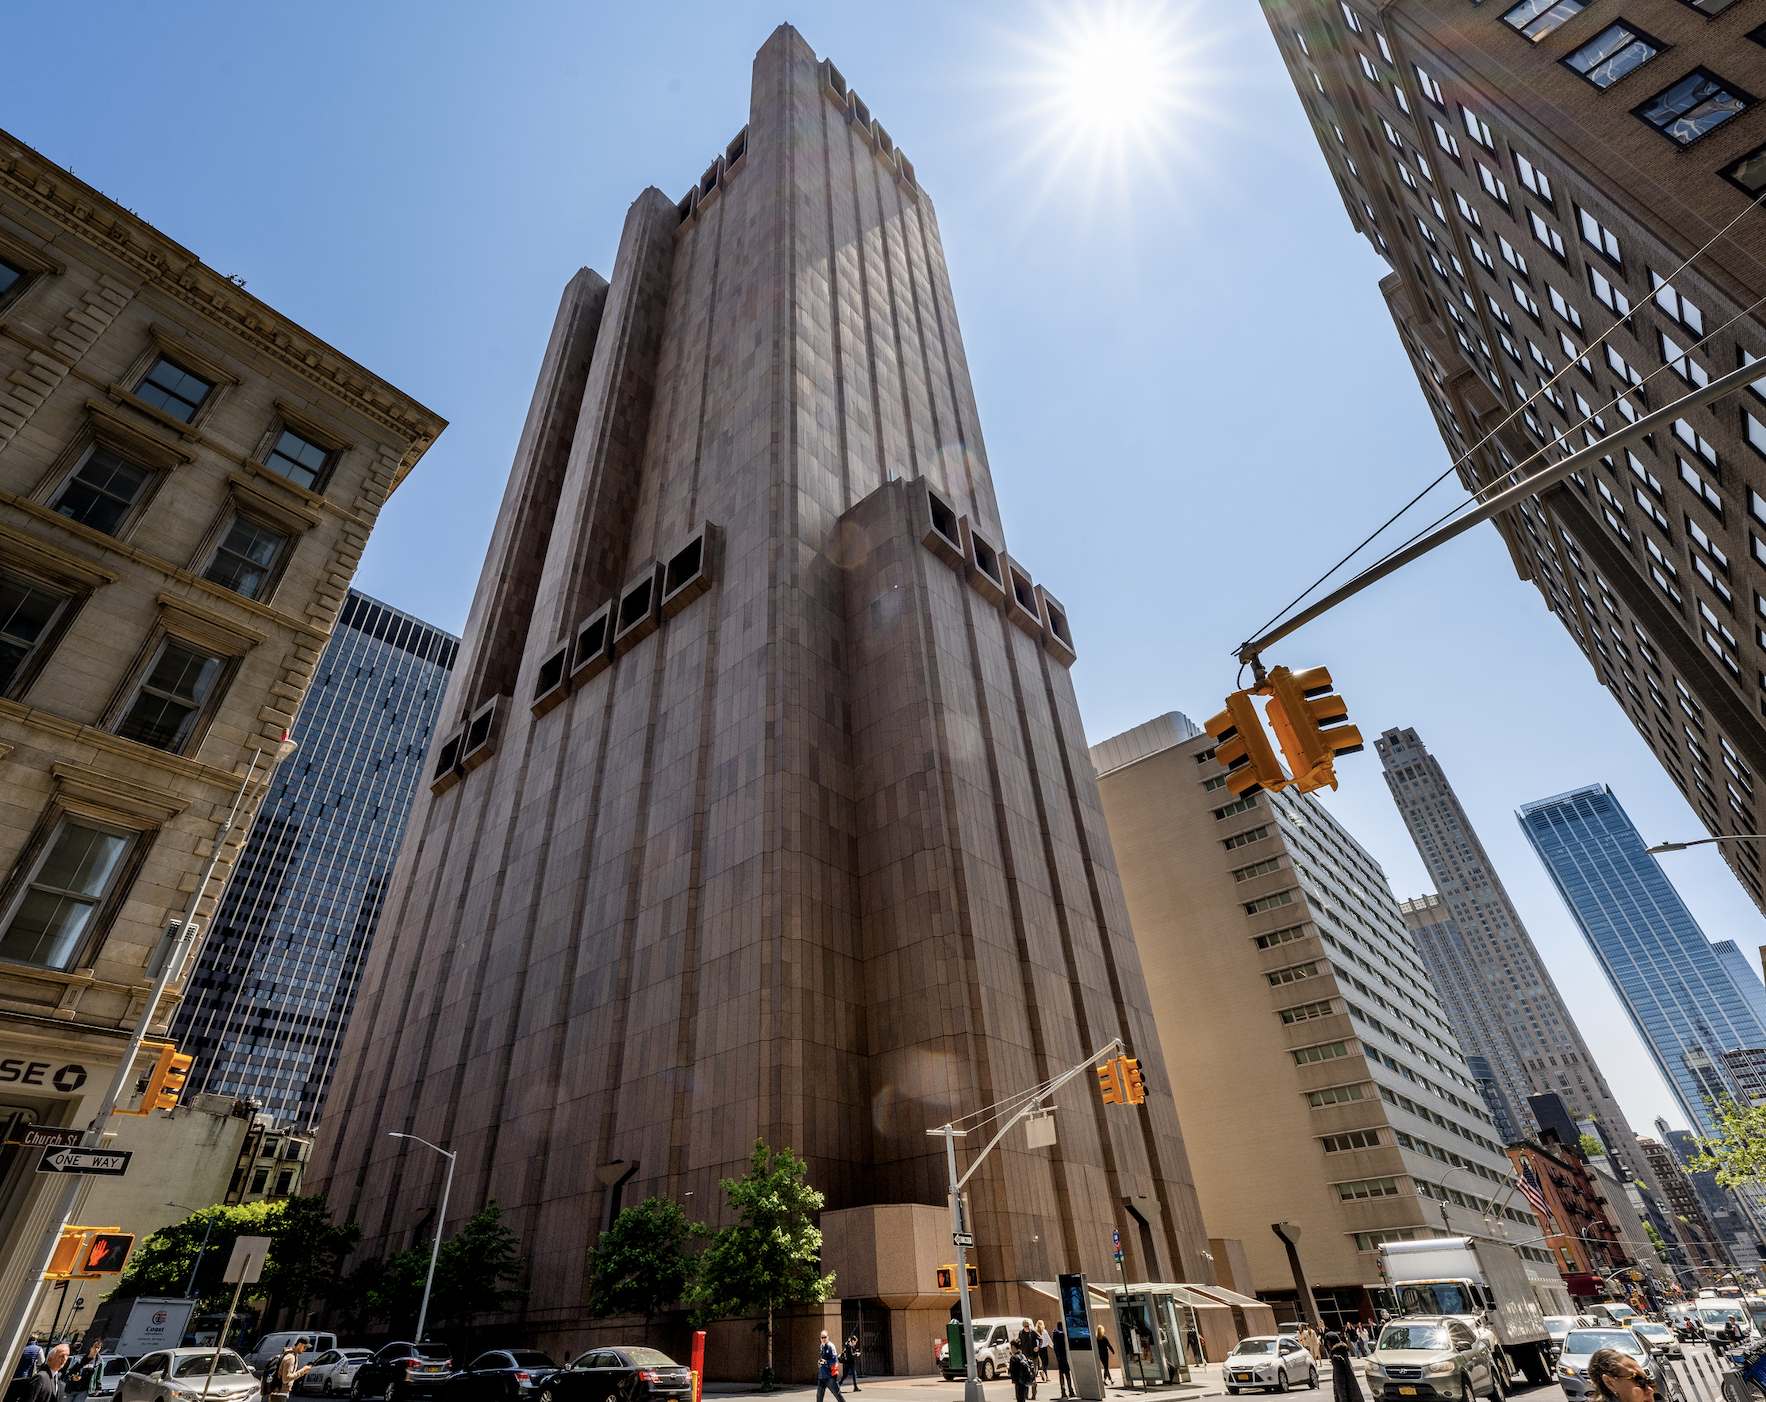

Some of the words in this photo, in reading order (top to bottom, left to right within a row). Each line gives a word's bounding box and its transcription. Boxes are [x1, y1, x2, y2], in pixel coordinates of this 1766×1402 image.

[25, 1131, 62, 1146] Church
[65, 1135, 78, 1146] St
[55, 1154, 82, 1167] ONE
[91, 1156, 119, 1168] WAY
